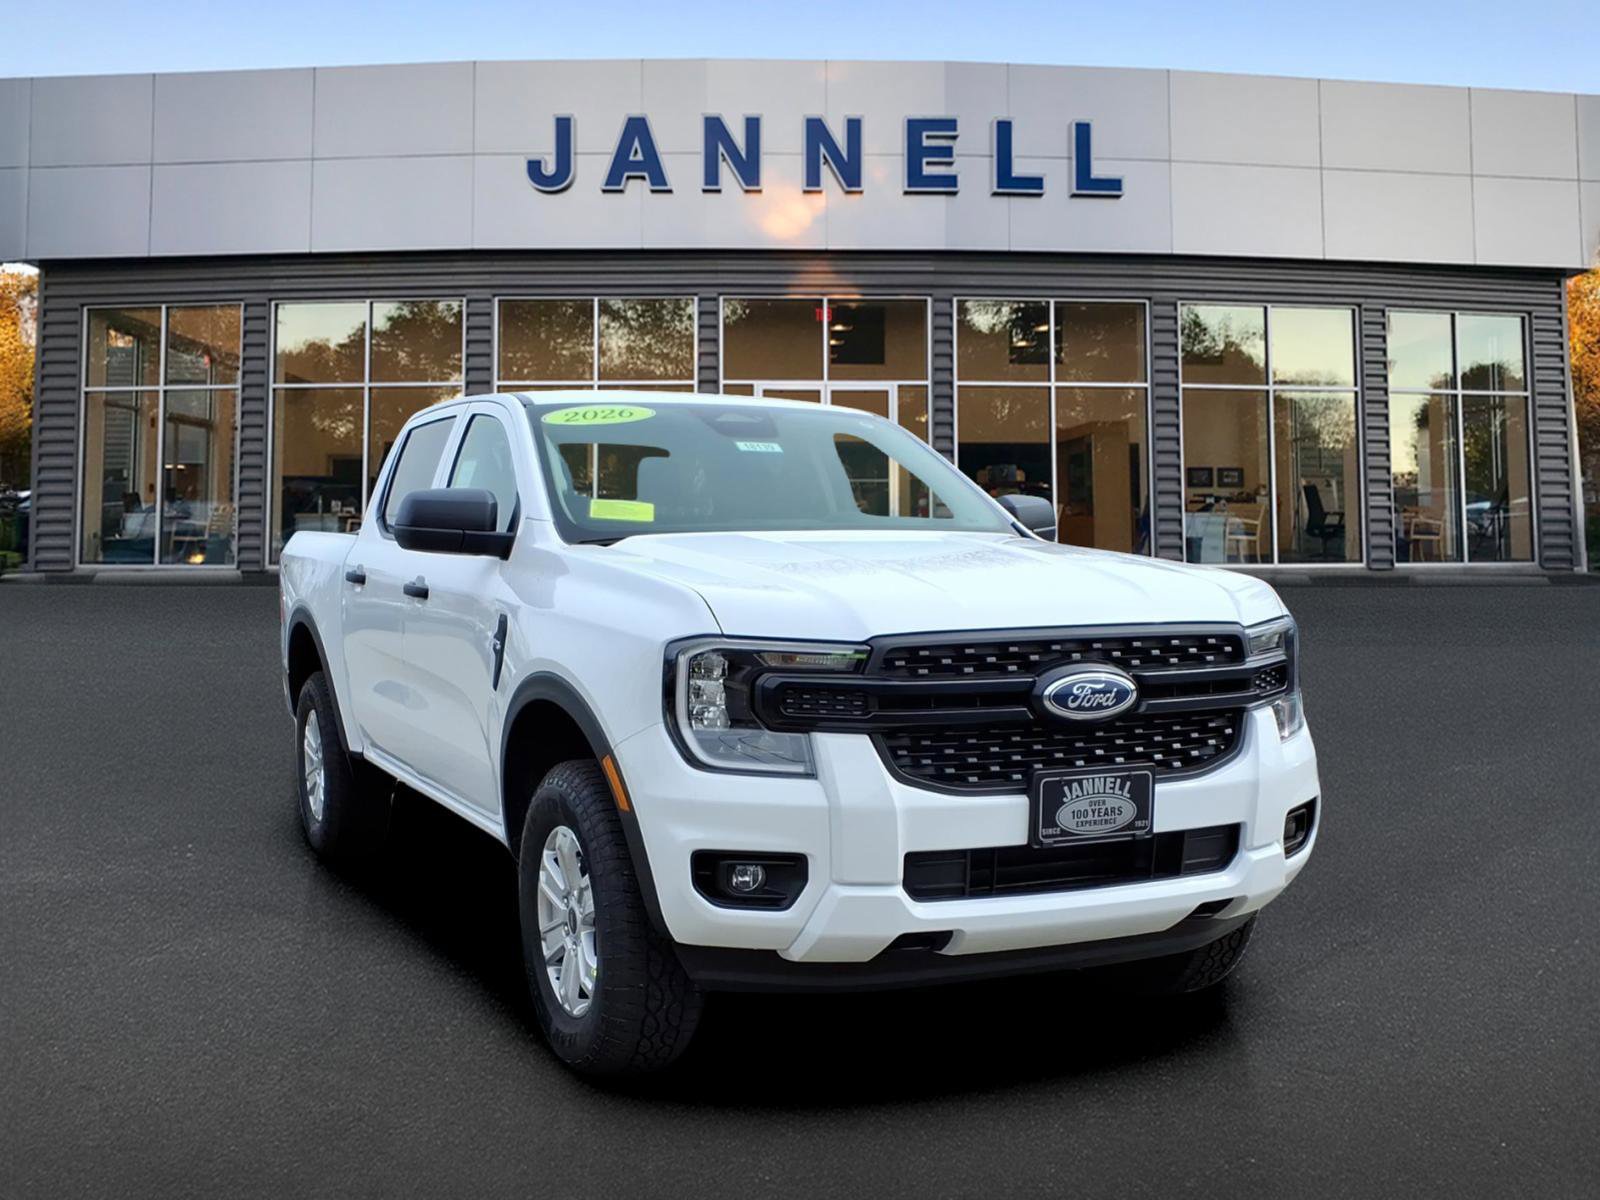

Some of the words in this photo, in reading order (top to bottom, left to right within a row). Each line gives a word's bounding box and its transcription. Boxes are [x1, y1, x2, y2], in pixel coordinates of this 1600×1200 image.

[526, 113, 1124, 198] JANNELL
[563, 408, 634, 423] 2026
[1068, 683, 1116, 709] Ford
[1062, 777, 1131, 802] JANNELL
[1088, 799, 1106, 807] OVER
[1071, 809, 1089, 820] 100
[1091, 805, 1123, 818] YEARS
[1075, 817, 1117, 828] EXPERIENCE
[1042, 827, 1061, 835] SINCE
